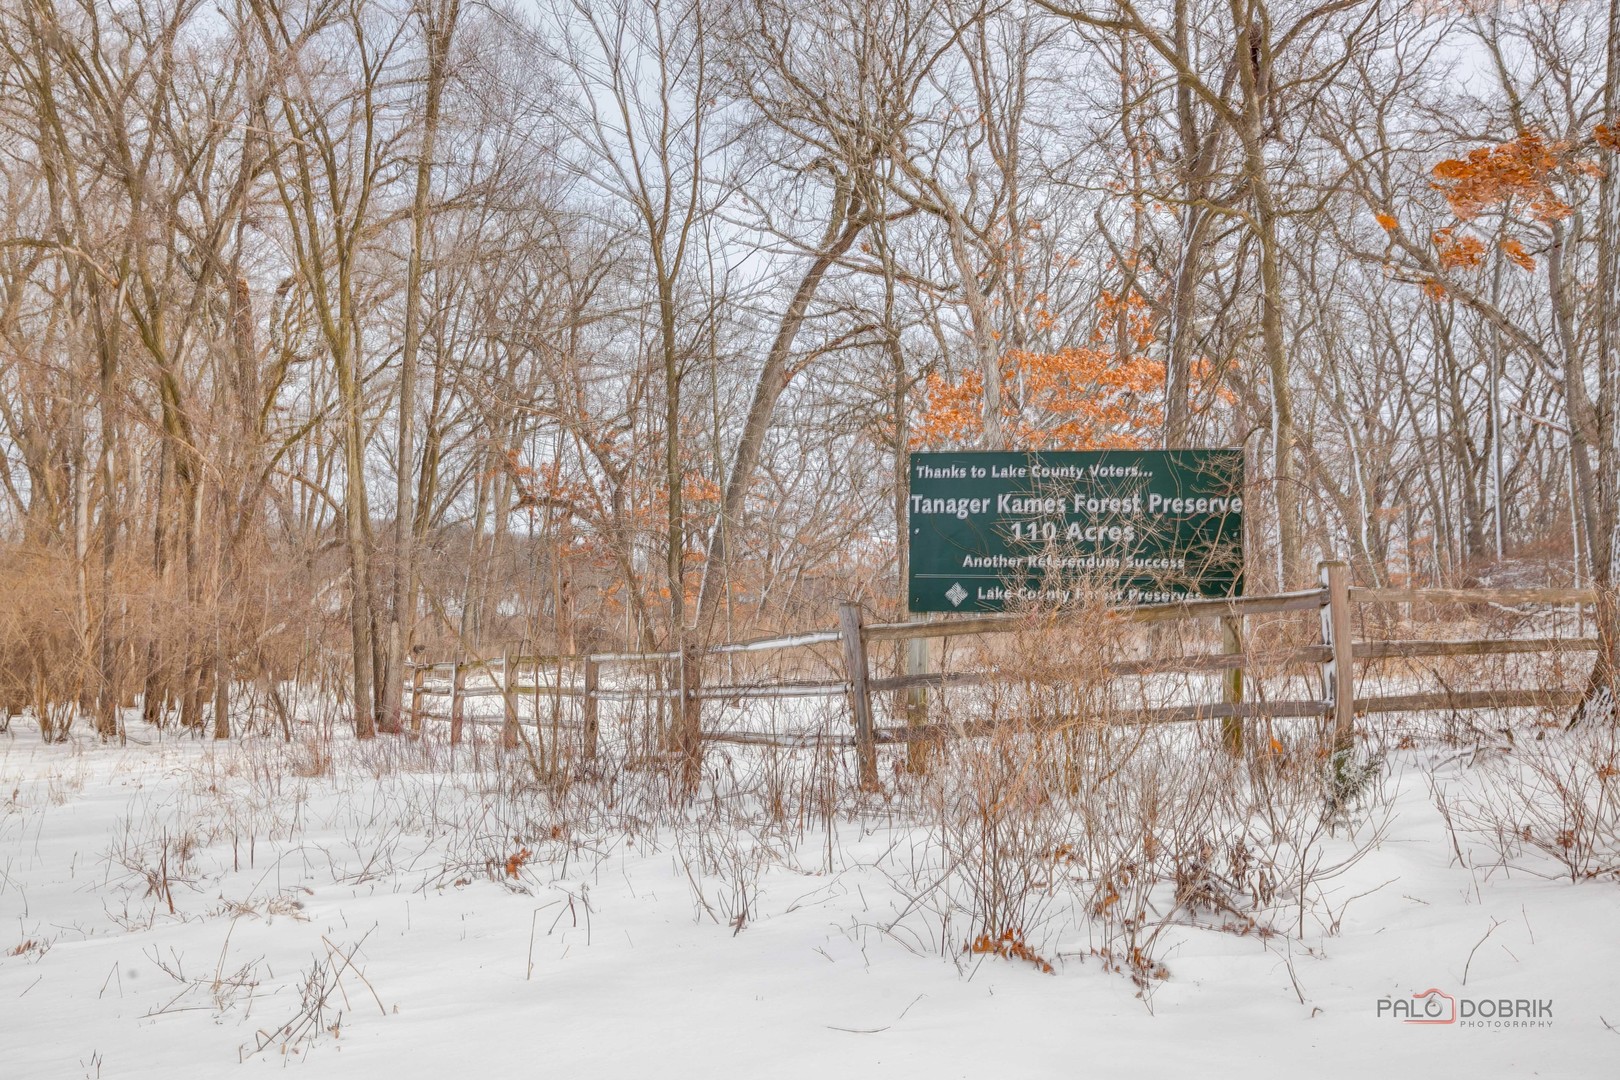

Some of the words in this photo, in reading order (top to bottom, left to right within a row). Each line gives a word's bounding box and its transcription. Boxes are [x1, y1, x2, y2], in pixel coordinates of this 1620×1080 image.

[916, 465, 967, 479] Thanks
[970, 465, 987, 479] to
[991, 464, 1026, 479] Lake
[1031, 464, 1084, 480] County
[1090, 463, 1153, 478] Voters...
[911, 493, 990, 519] Tanager
[997, 493, 1066, 514] Kames
[1073, 493, 1141, 514] Forest
[1149, 493, 1243, 514] Preserve
[1011, 521, 1057, 541] 110
[1066, 521, 1135, 542] Acres
[962, 553, 1021, 568] Another
[1125, 555, 1185, 569] Success
[978, 586, 1012, 600] Lake
[1017, 586, 1070, 603] Conty
